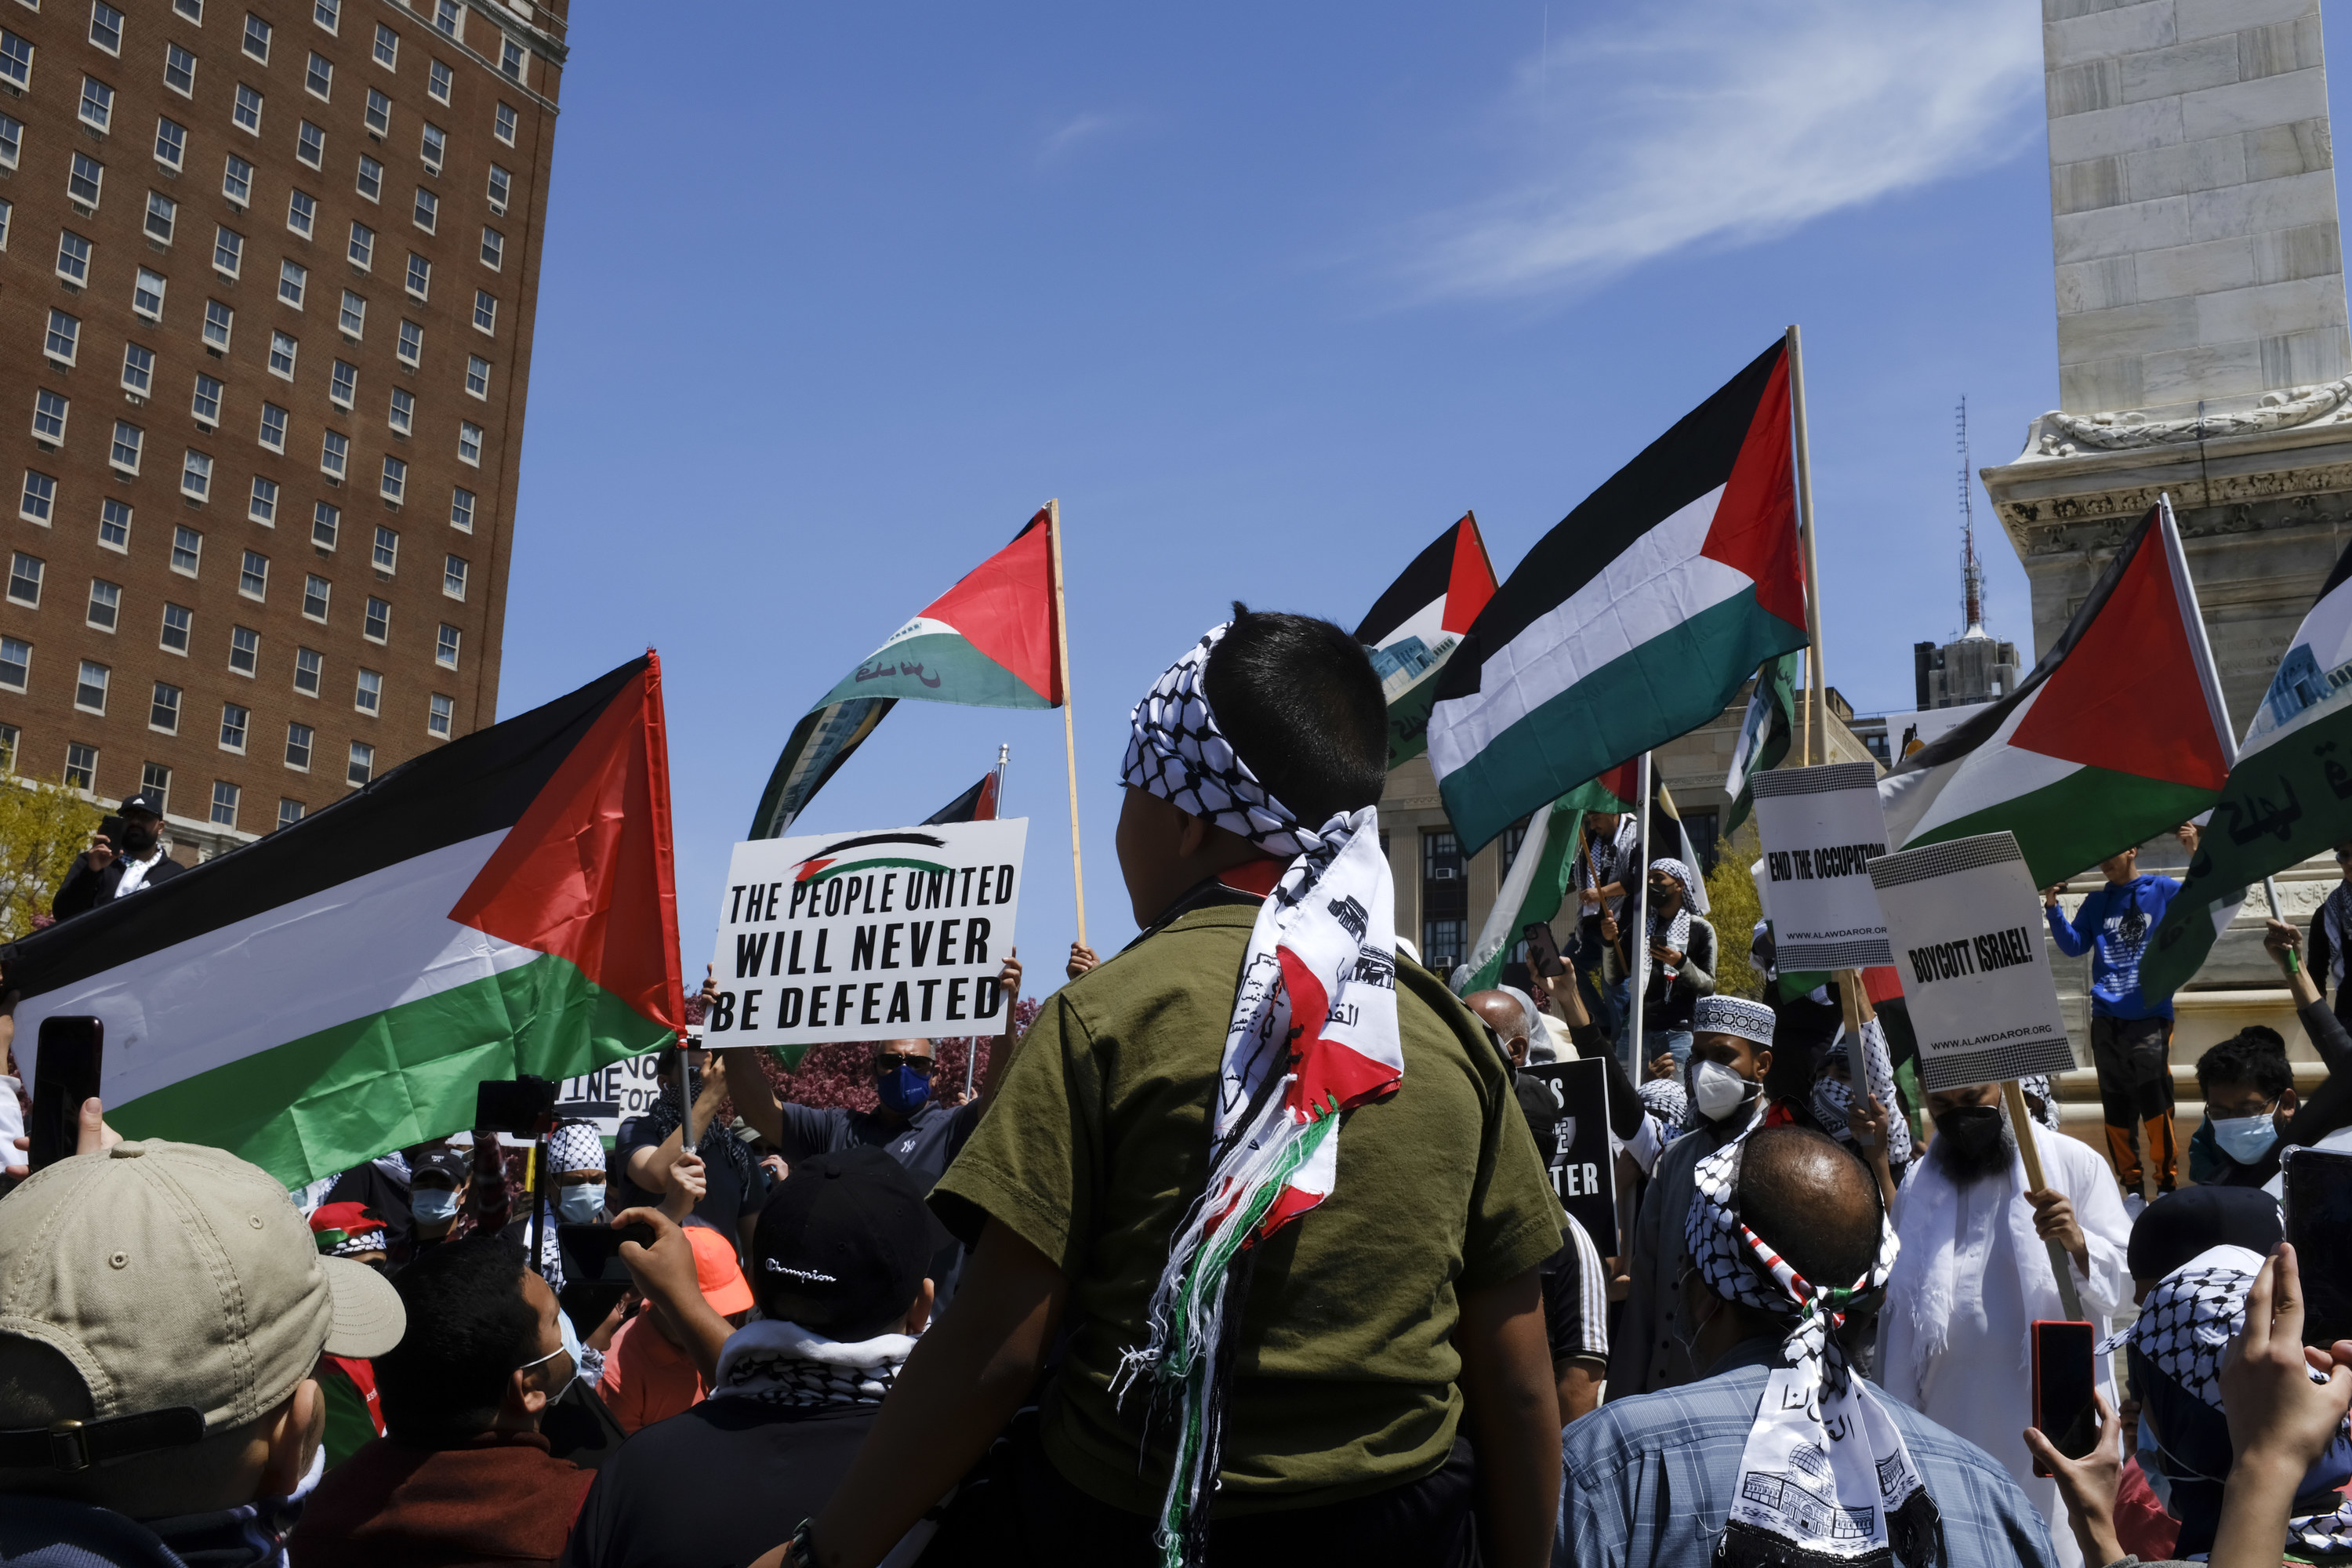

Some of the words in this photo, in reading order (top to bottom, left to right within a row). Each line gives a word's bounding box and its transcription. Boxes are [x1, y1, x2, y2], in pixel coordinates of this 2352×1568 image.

[1768, 851, 1792, 881] END
[1792, 850, 1814, 880] THE
[730, 882, 782, 924] THE
[788, 873, 898, 920] PEOPLE
[905, 864, 1014, 912] UNITED
[735, 927, 833, 979] WILL
[851, 917, 991, 971] NEVER
[1786, 927, 1887, 940] WWW.ALAWDAROR.OR
[1908, 939, 1975, 983] BOYCOTT
[1973, 926, 2033, 972] ISRAEL!
[710, 989, 763, 1033] BE
[777, 976, 1001, 1029] DEFEATED
[1930, 1024, 2053, 1051] WWW.ALAWDAROR.ORG
[766, 1258, 837, 1283] Champion
